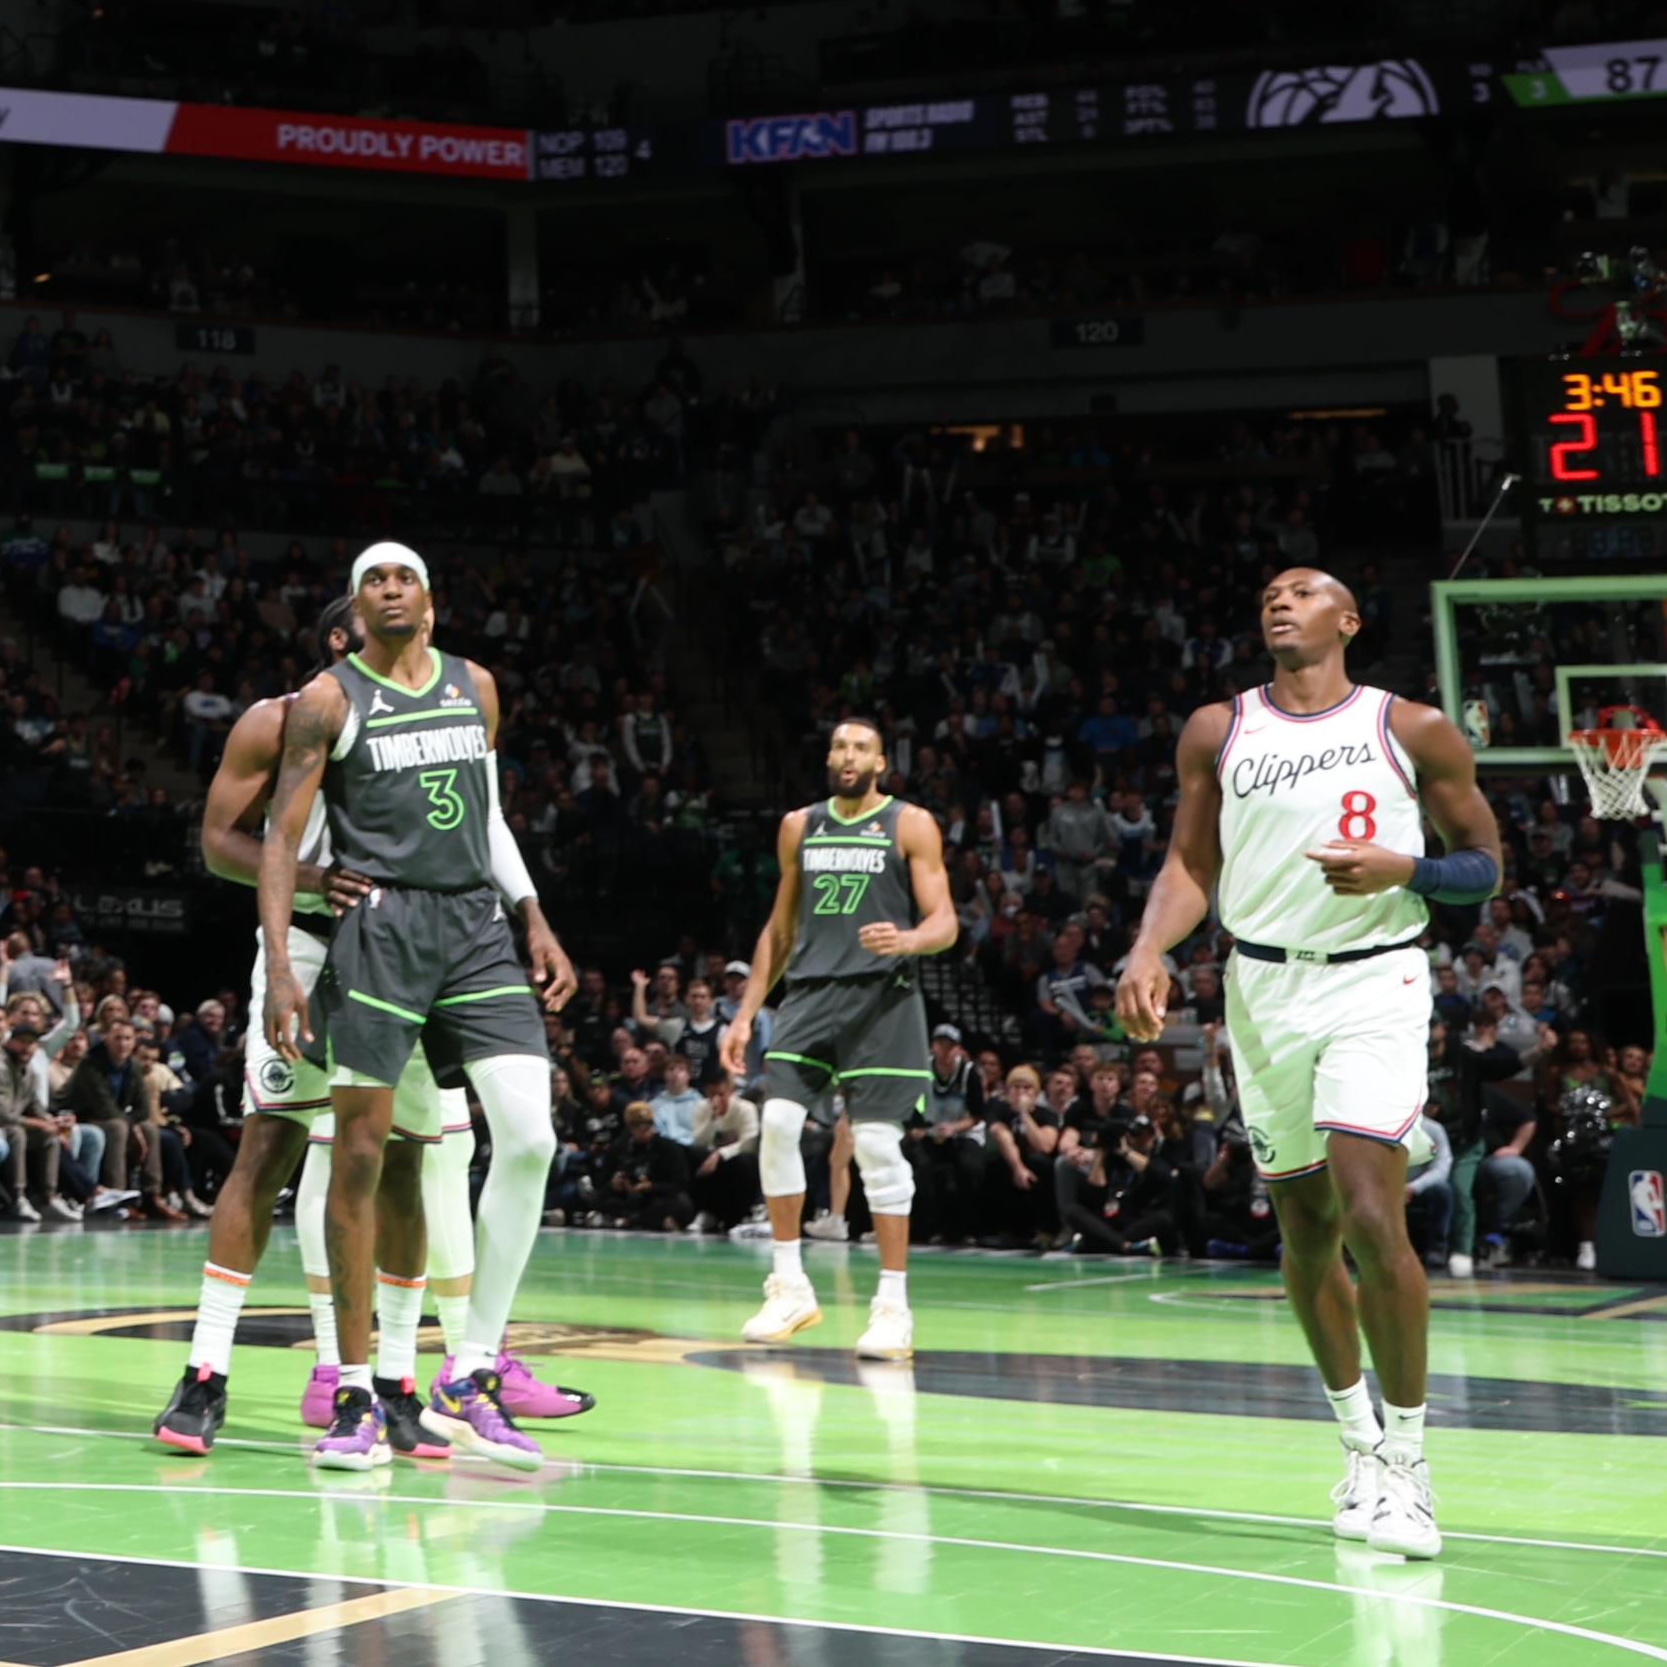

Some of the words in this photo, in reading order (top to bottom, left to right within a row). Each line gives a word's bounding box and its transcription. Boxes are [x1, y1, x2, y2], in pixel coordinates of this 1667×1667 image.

[1605, 56, 1662, 94] 87
[277, 122, 414, 159] PROUDLY
[419, 131, 524, 168] POWER
[725, 109, 859, 166] KFAN
[195, 327, 237, 352] 118
[1074, 318, 1120, 344] 120
[1561, 370, 1663, 412] 3:46
[1548, 411, 1662, 482] 21
[365, 724, 487, 774] TIMBERWOLVES
[1232, 740, 1378, 800] Clippers
[419, 768, 465, 831] 3
[1338, 789, 1378, 842] 8
[73, 896, 185, 918] LEXUS
[812, 873, 871, 915] 27
